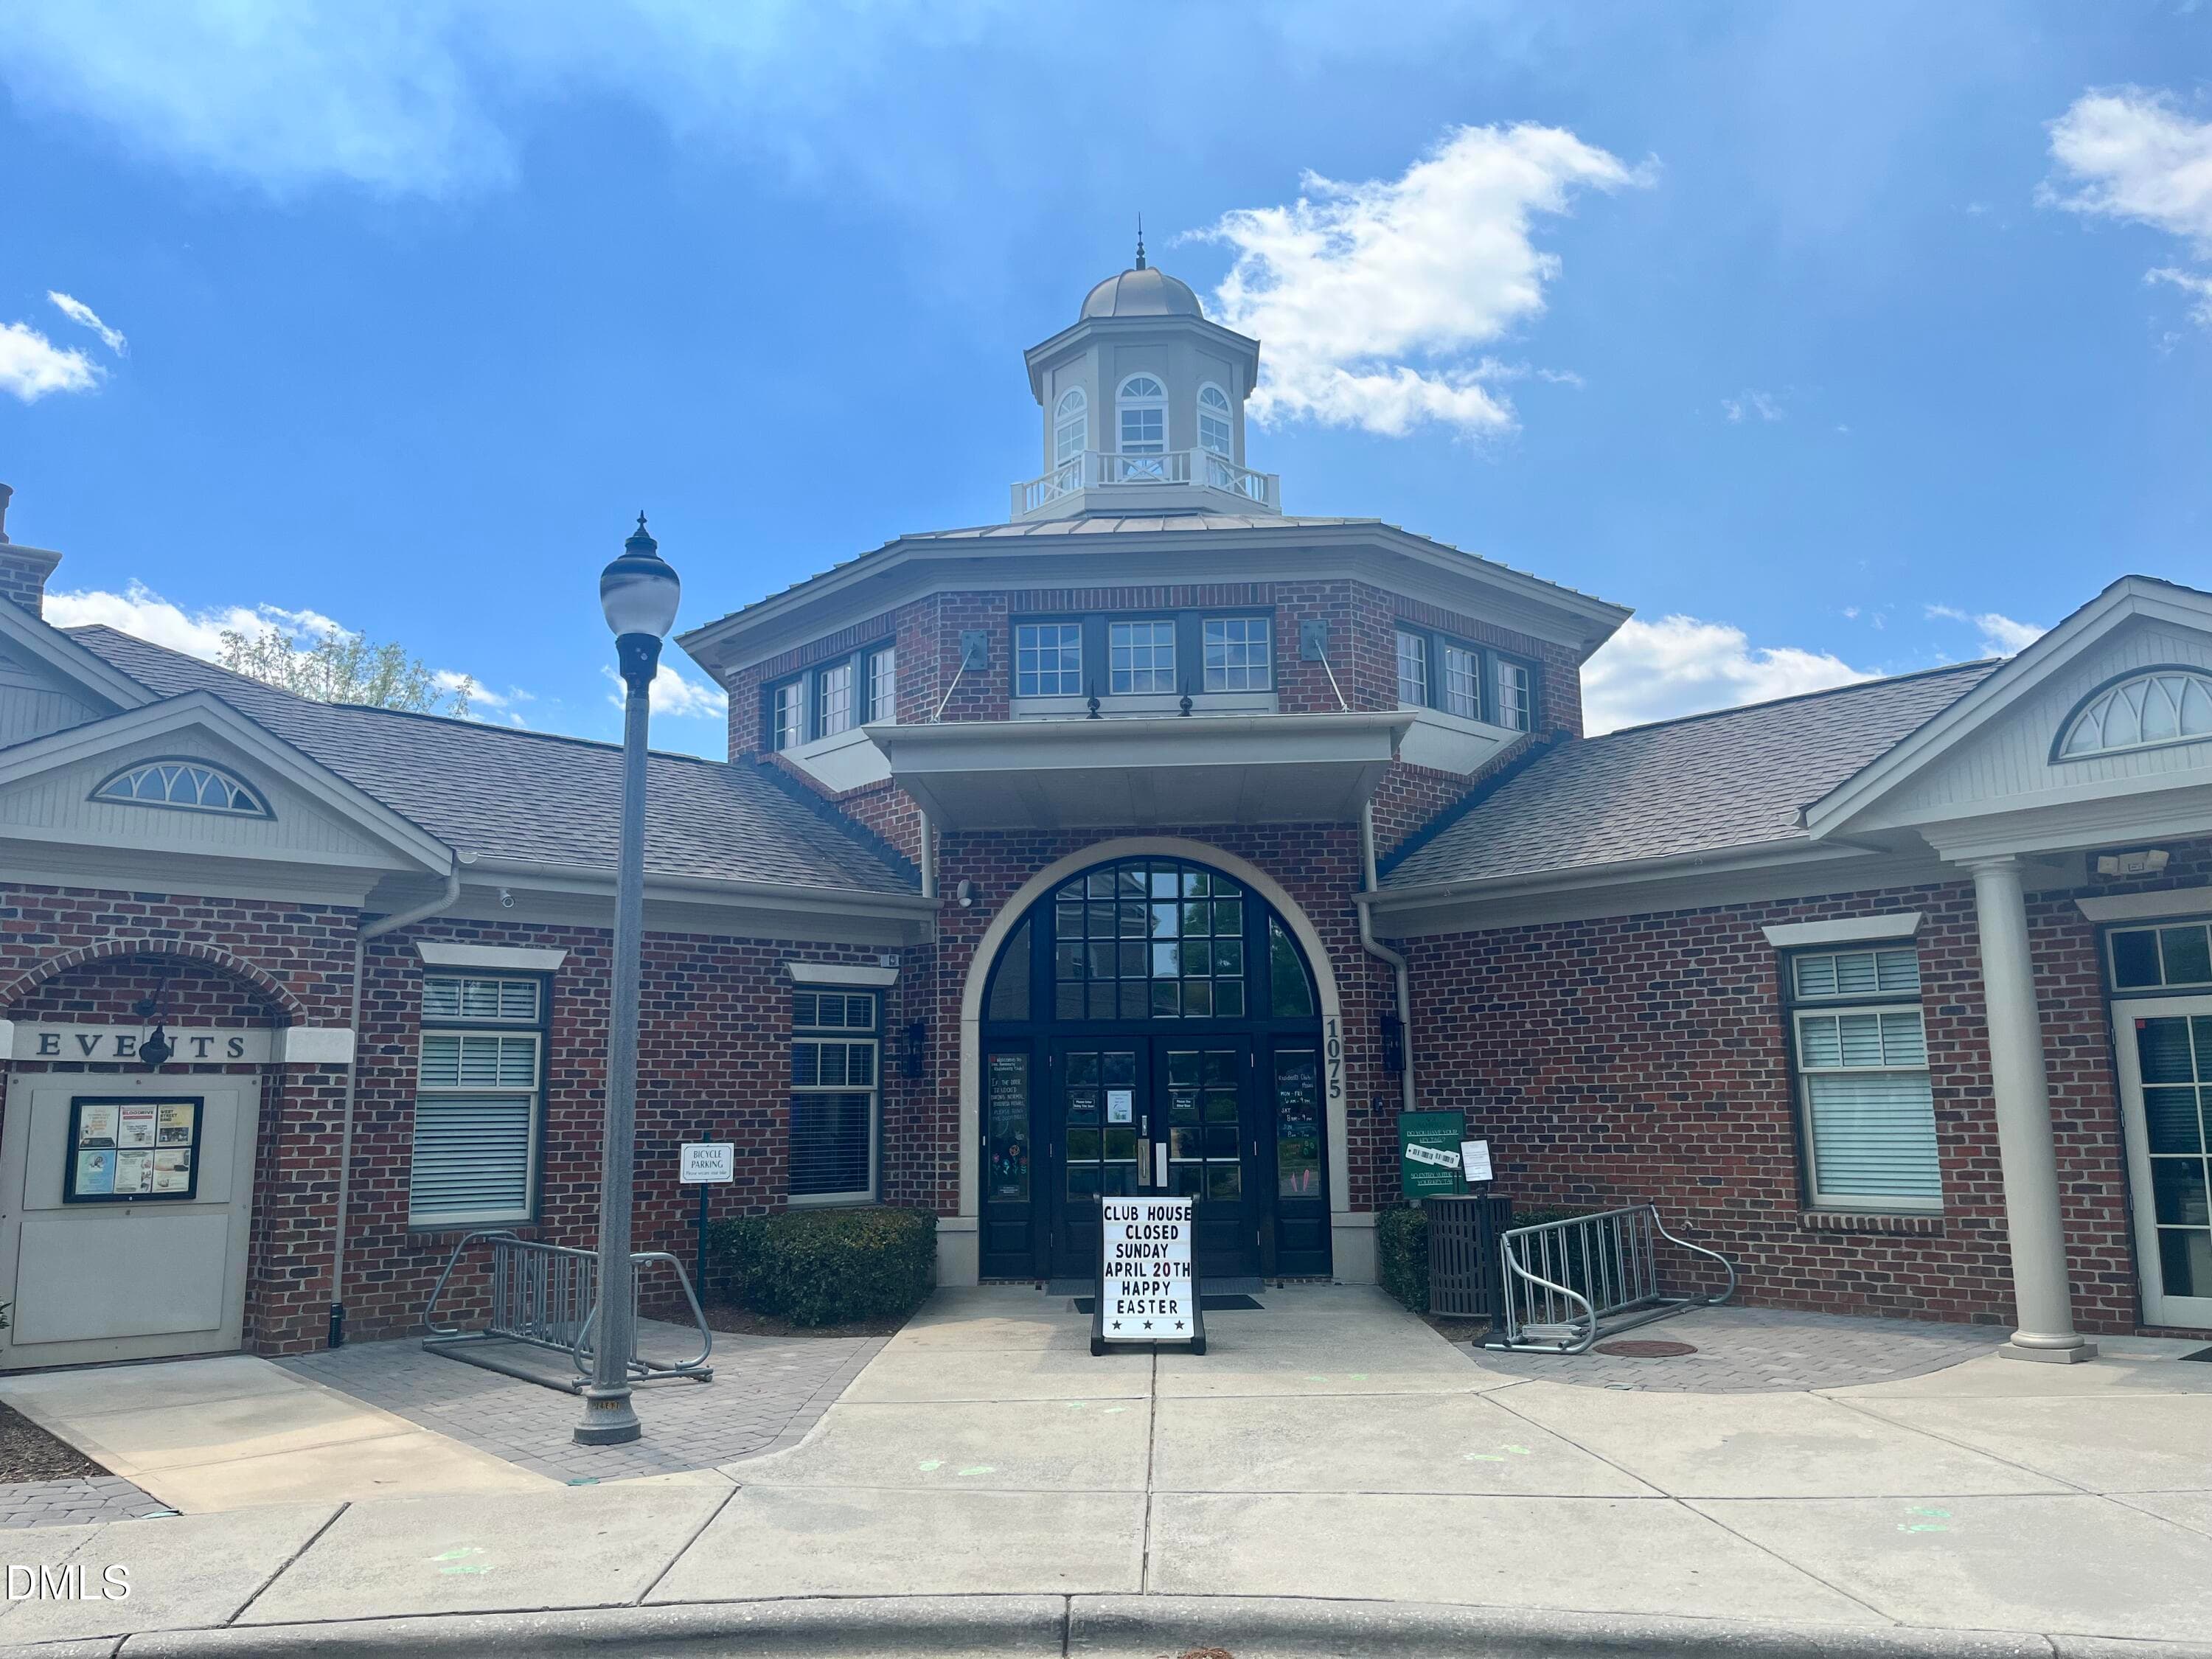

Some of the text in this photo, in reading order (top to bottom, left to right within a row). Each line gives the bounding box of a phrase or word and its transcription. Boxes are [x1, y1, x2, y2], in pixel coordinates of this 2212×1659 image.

[1327, 1019, 1341, 1099] 1075
[693, 1150, 722, 1158] BICYCLE
[692, 1160, 723, 1169] PARKING
[1105, 1206, 1192, 1221] CLUB HOUSE
[1126, 1225, 1178, 1239] CLOSED
[1116, 1243, 1168, 1259] SUNDAY
[1105, 1262, 1190, 1277] APRIL 20TH
[1122, 1281, 1171, 1295] HAPPY
[1117, 1299, 1178, 1314] EASTER
